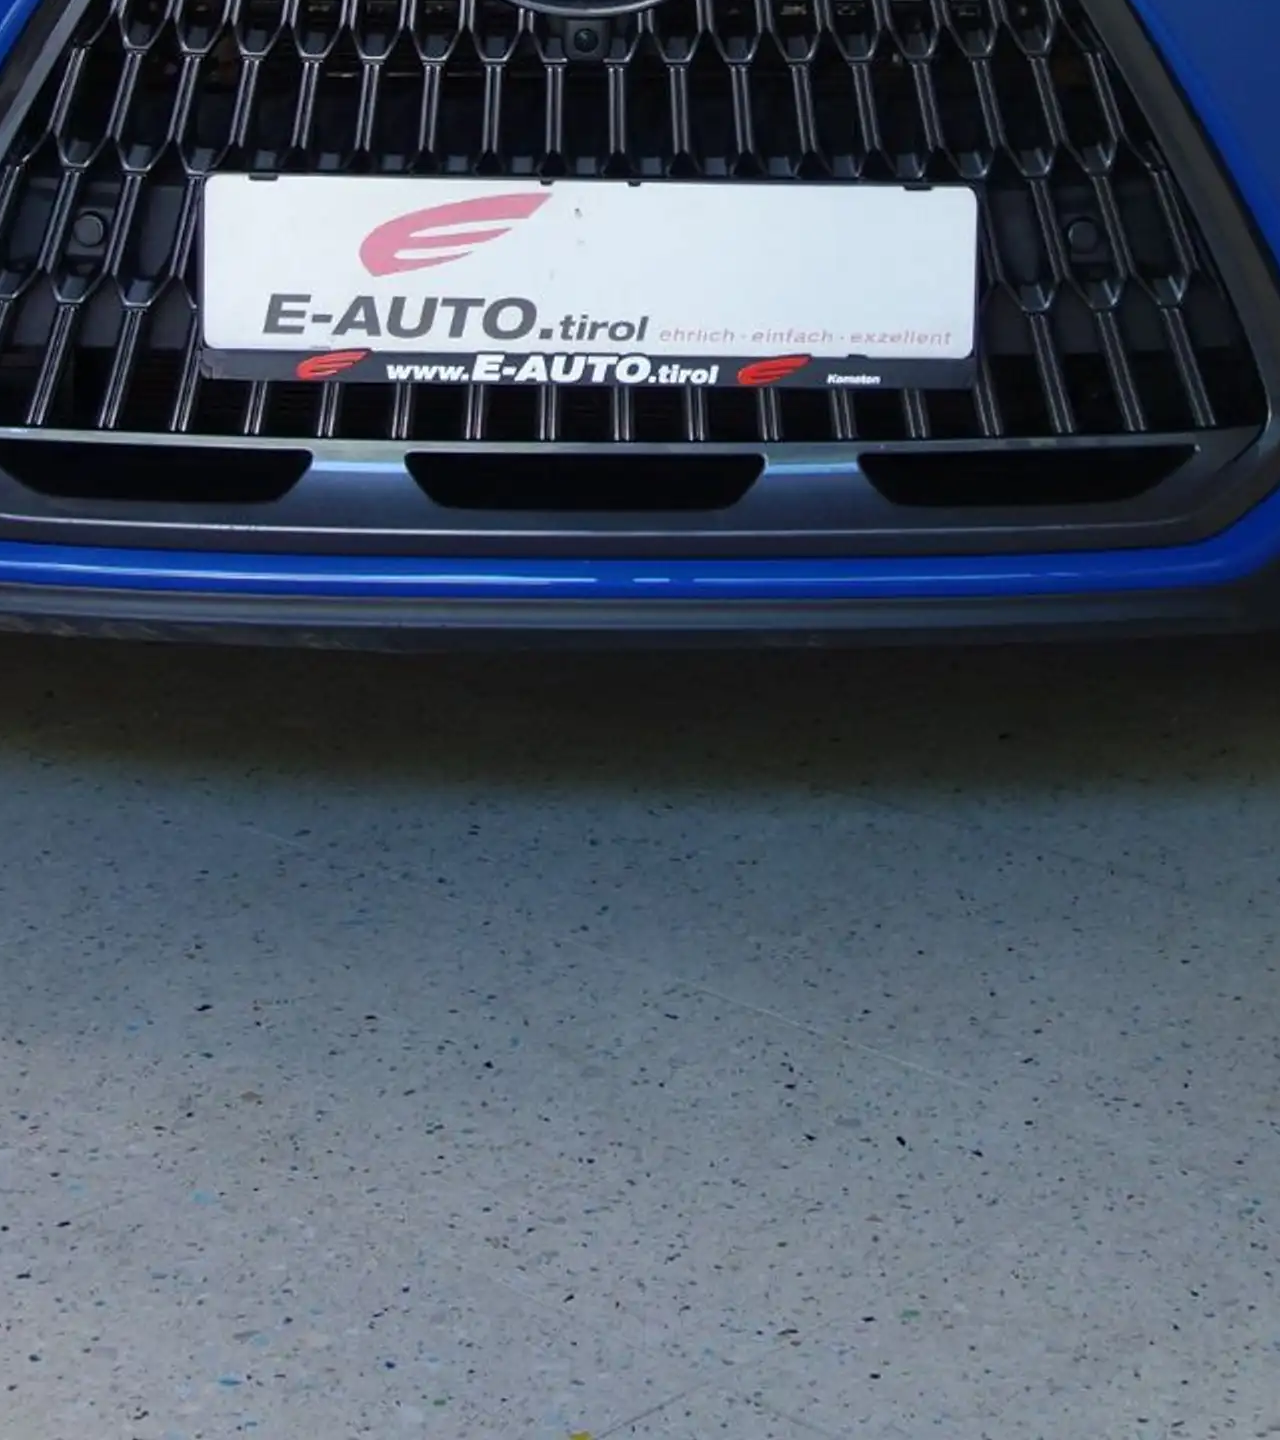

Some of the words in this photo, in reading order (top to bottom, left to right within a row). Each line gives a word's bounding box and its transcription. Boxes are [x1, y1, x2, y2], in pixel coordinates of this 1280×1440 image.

[262, 292, 650, 342] E-AUTO.tirol
[659, 327, 735, 344] ehrlich
[751, 328, 834, 345] einfach
[850, 329, 952, 346] exzellent
[385, 353, 720, 386] www.E-AUTO.tirol
